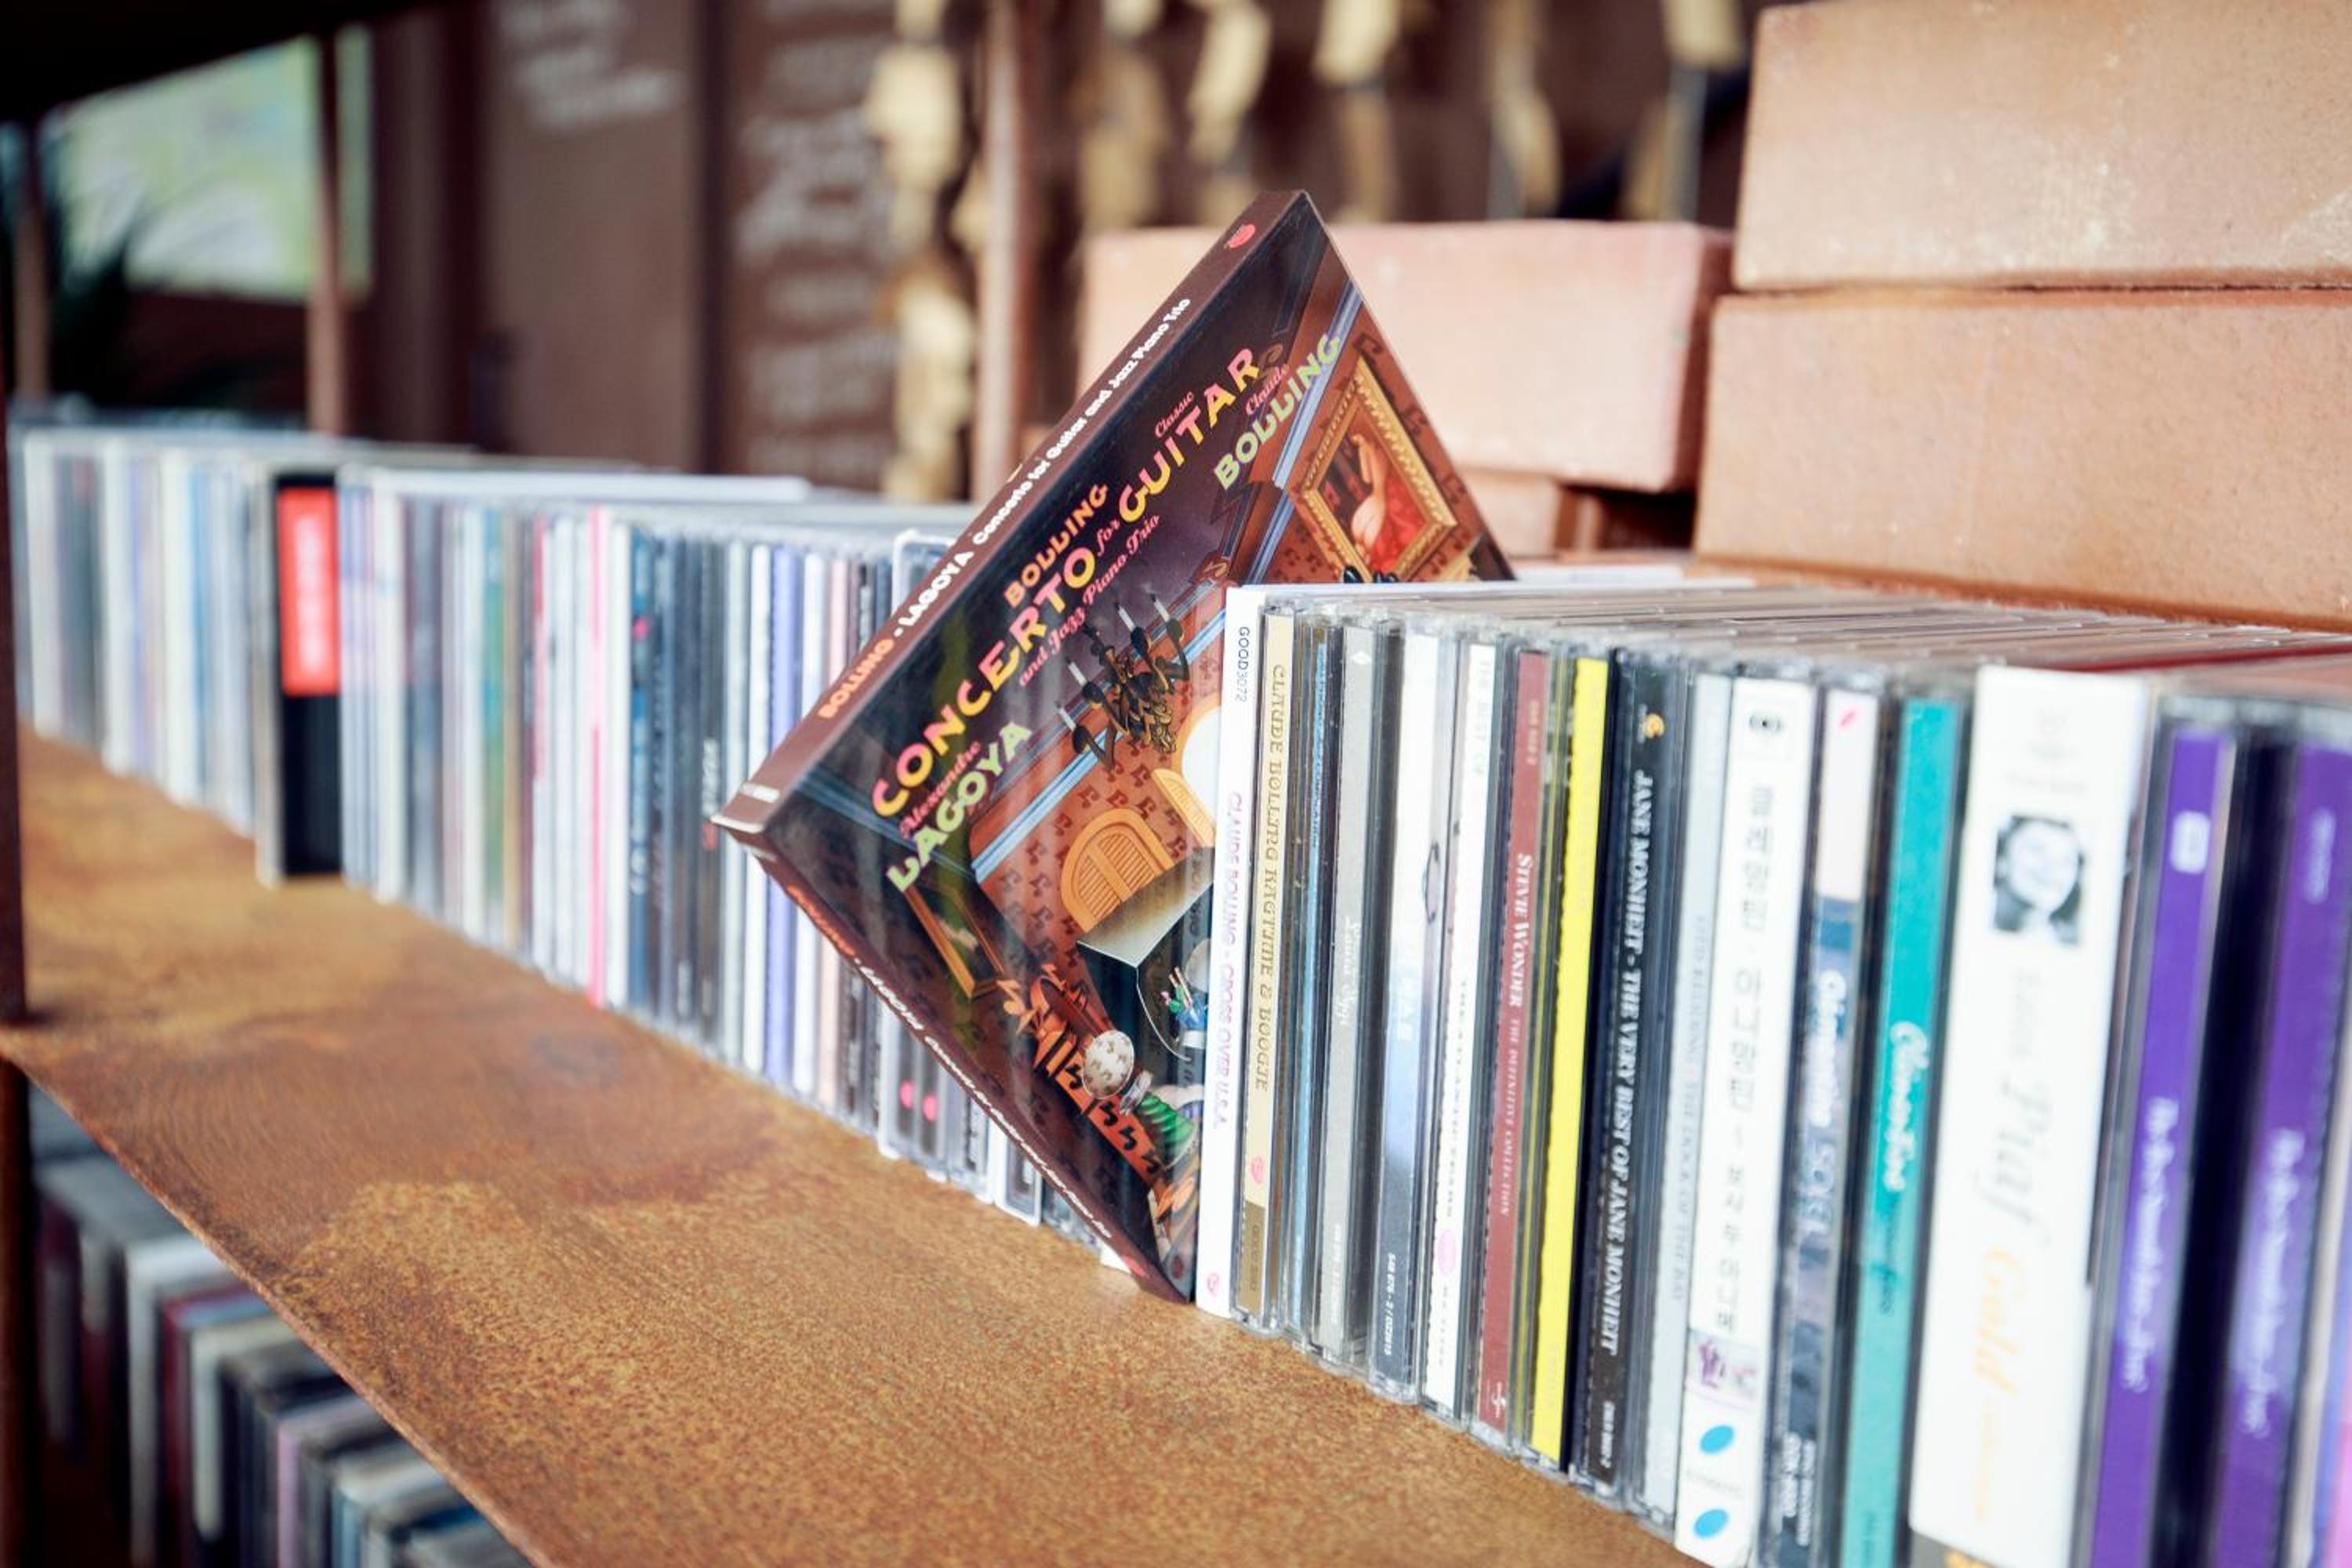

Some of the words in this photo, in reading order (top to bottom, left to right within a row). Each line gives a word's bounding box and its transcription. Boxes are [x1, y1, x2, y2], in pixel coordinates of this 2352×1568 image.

[1154, 391, 1195, 438] Classic
[1214, 334, 1341, 490] BOLLING
[817, 638, 895, 718] BOLLING
[898, 550, 975, 626] LAGOYA
[973, 480, 1033, 544] Concerto
[1046, 417, 1087, 459] Guitar
[1085, 390, 1113, 416] and
[1108, 360, 1139, 389] Jazz
[1131, 322, 1170, 359] Piano
[1163, 299, 1191, 322] Trio
[1004, 483, 1108, 608] BOLLING
[872, 546, 1096, 817] CONCERTO
[1097, 518, 1121, 557] for
[1119, 348, 1260, 522] GUITAR
[1019, 645, 1049, 687] and
[1047, 606, 1087, 654] Jazz
[1083, 554, 1128, 605] Piano
[1125, 514, 1160, 555] Trio
[1269, 664, 1287, 754] CLAUDE
[886, 720, 1033, 893] LAGOYA
[1265, 760, 1283, 862] BOLLING
[1631, 768, 1653, 836] JANE
[1512, 851, 1534, 918] STEVIE
[1624, 837, 1650, 955] MONHEIT
[1508, 921, 1531, 1008] WONDER
[1621, 968, 1642, 1021] THE
[1254, 1005, 1272, 1093] BOOGIE
[1617, 1022, 1639, 1085] VERY
[1611, 1085, 1634, 1145] BEST
[1610, 1146, 1630, 1181] OF
[1607, 1178, 1628, 1243] JANE
[1601, 1245, 1625, 1356] MONHEIT
